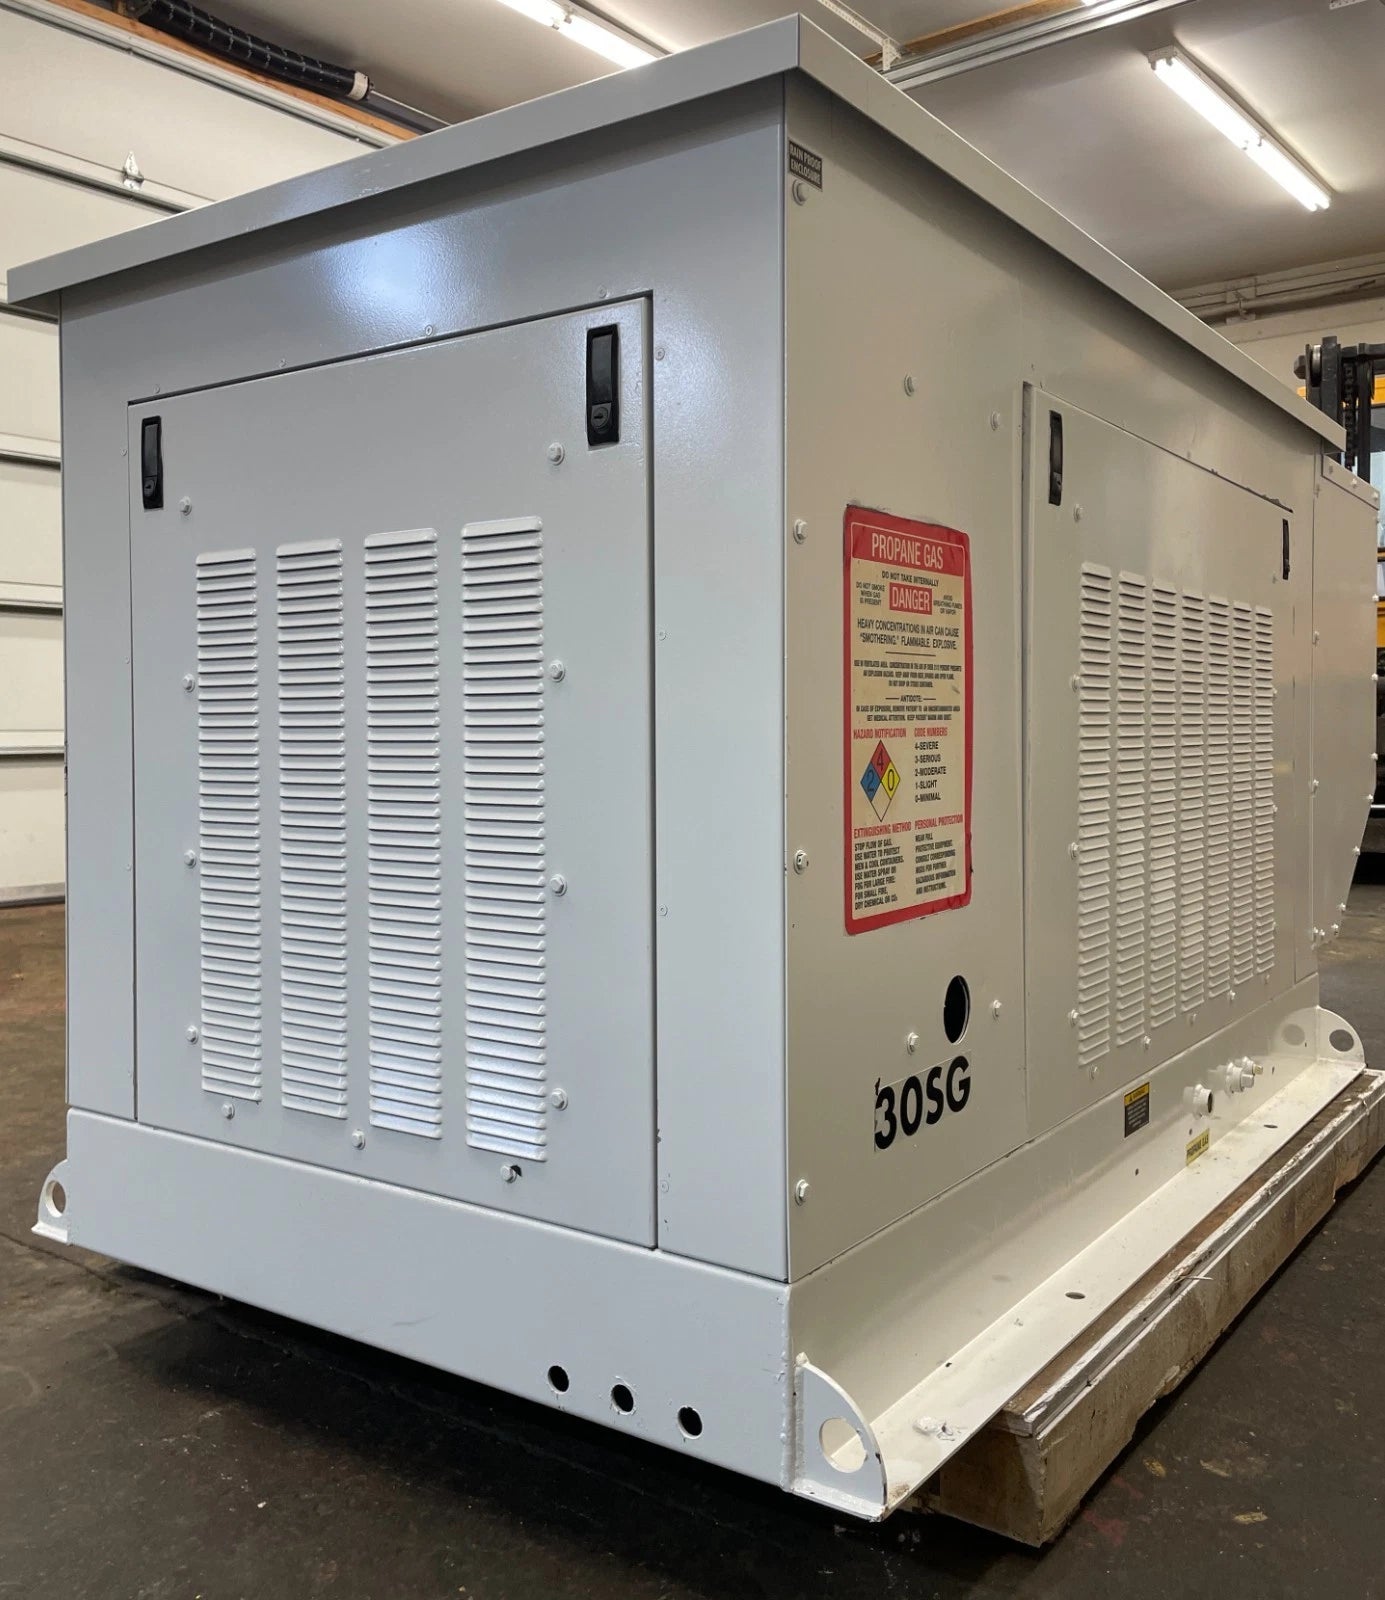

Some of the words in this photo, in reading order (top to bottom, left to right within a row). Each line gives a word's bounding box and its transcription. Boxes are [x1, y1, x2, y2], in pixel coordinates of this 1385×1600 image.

[872, 532, 921, 566] PROPANE
[923, 543, 944, 570] GAS
[882, 570, 890, 580] DO
[890, 572, 901, 581] NOT
[901, 574, 913, 583] TAKE
[913, 576, 940, 587] INTERNALLY
[892, 586, 931, 612] DANGER
[857, 618, 874, 630] HEAVY
[875, 620, 920, 635] CONCENTRATIONS
[920, 624, 926, 634] IN
[926, 625, 934, 634] AIR
[934, 626, 945, 636] CAN
[945, 627, 960, 637] CAUSE
[854, 728, 873, 740] HAZARD
[874, 727, 907, 738] NOTIFICATION
[915, 741, 939, 750] 4-SEVERE
[876, 749, 884, 772] 4
[915, 754, 942, 763] 3-SERIOUS
[915, 766, 947, 776] 2-MODERATE
[867, 768, 875, 792] 2
[887, 768, 895, 792] 0
[915, 779, 938, 789] 1-SLIGHT
[914, 792, 941, 803] 0-MINIMAL
[854, 824, 891, 839] EXTINGUISHING
[892, 821, 912, 833] METHOD
[914, 817, 938, 830] PERSONAL
[938, 814, 963, 826] PROTECTION
[855, 842, 865, 851] STOP
[855, 852, 863, 861] USE
[855, 871, 863, 880] USE
[875, 1055, 971, 1150] 30SG
